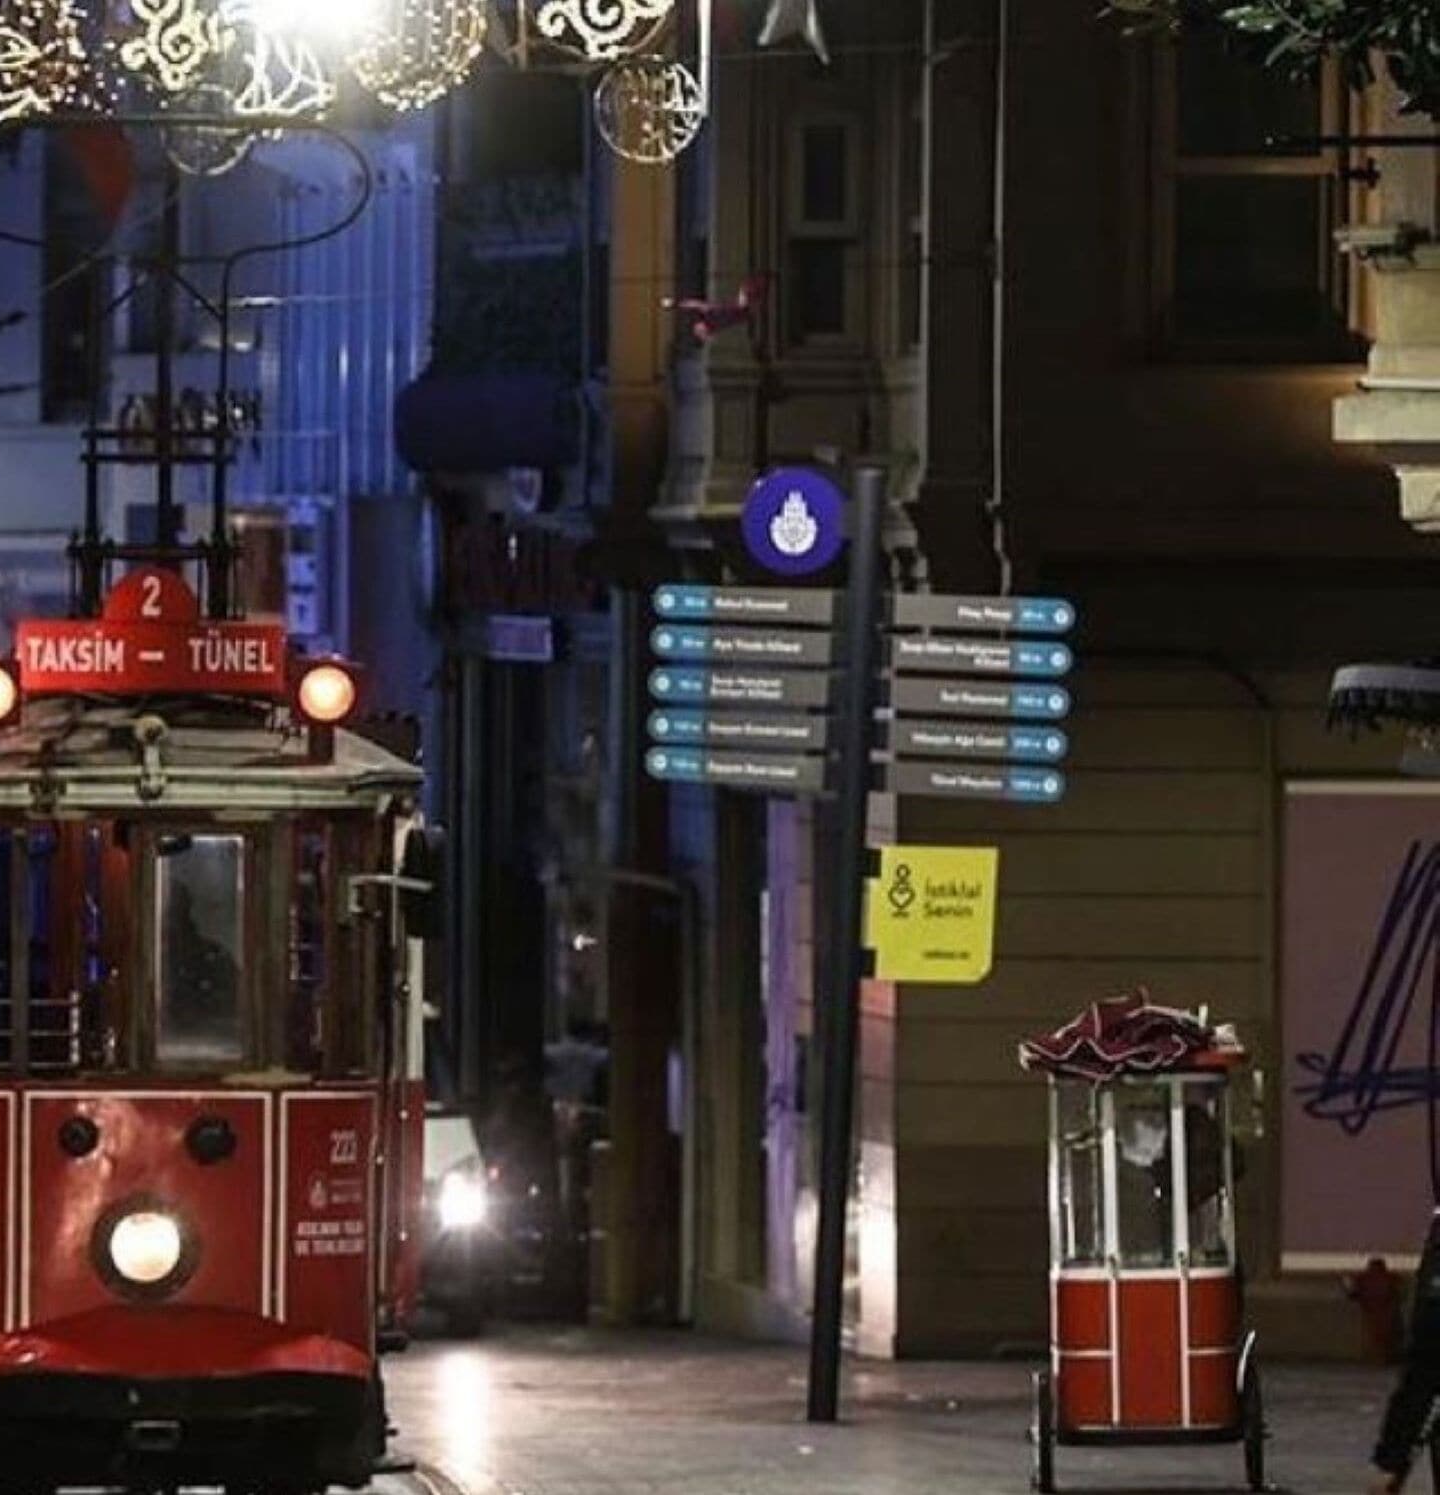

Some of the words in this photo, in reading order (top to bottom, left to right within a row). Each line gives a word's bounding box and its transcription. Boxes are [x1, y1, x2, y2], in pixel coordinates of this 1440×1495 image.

[141, 576, 162, 616] 2
[26, 630, 125, 672] TAKSİM
[188, 630, 275, 672] TÜNEL
